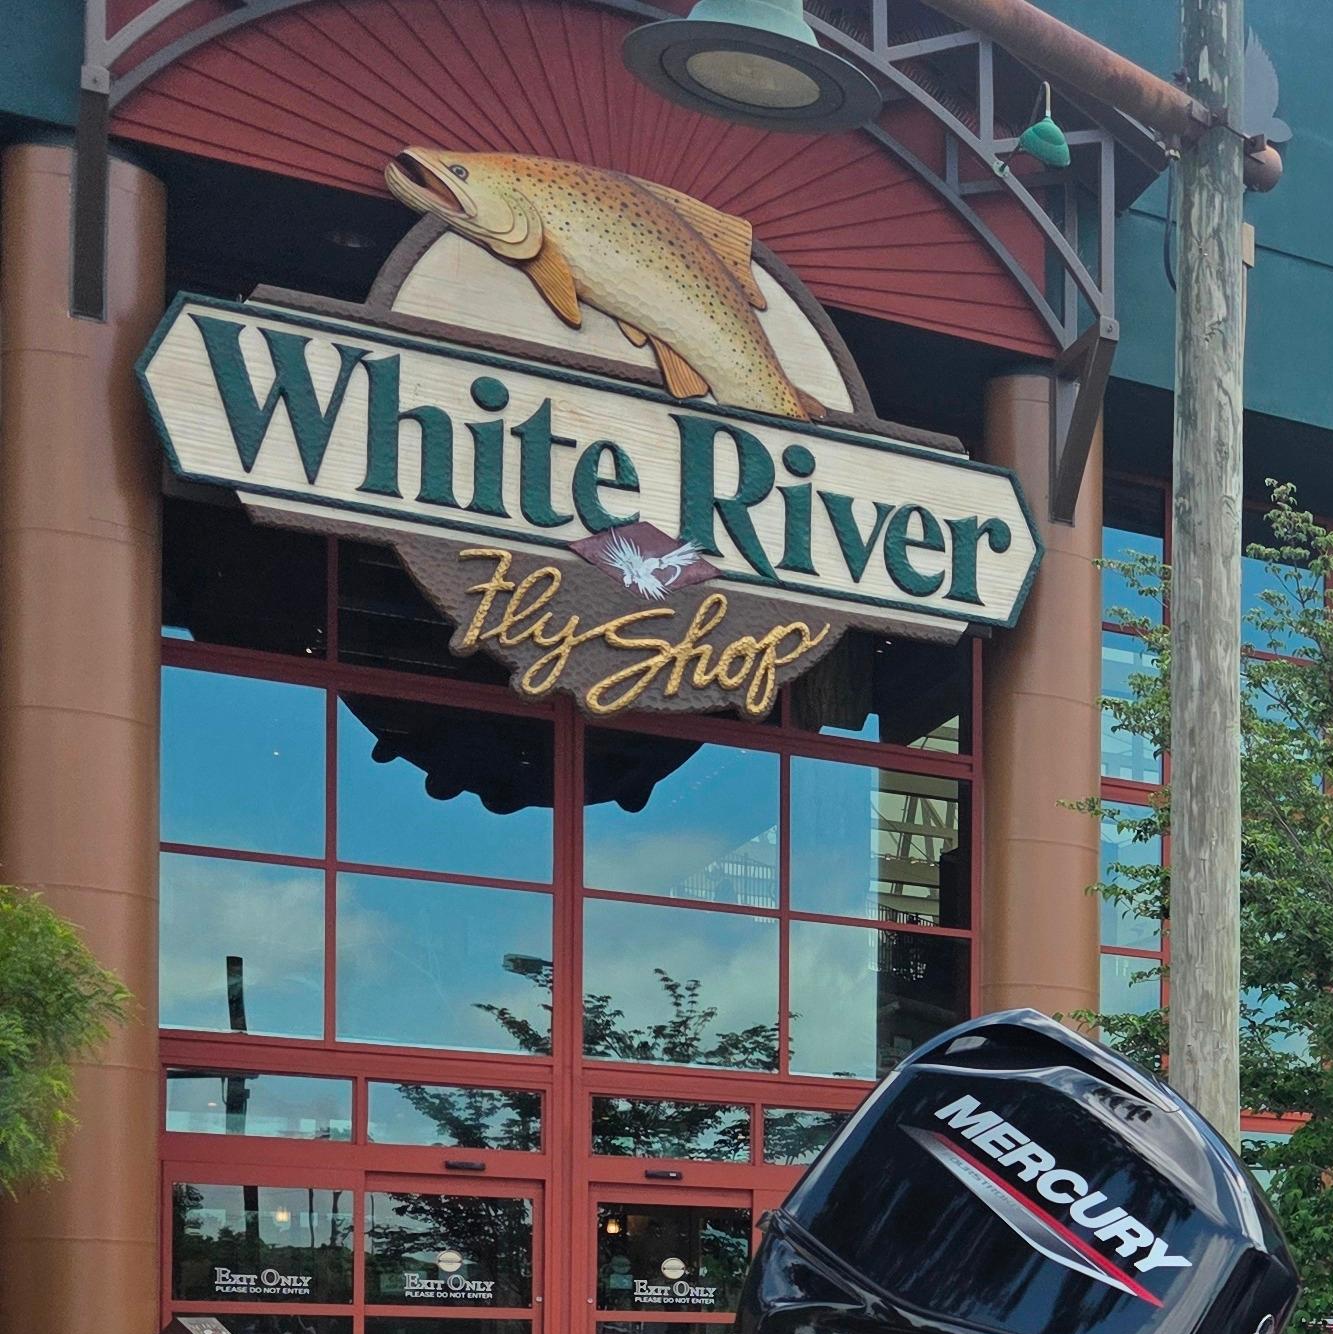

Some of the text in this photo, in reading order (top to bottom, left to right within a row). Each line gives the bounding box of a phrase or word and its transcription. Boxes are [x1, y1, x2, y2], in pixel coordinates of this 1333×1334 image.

[189, 312, 1012, 605] White River
[452, 548, 830, 716] Fly Shop
[934, 1094, 1193, 1273] MERCURY
[215, 1286, 247, 1294] PLEASE
[283, 1287, 310, 1295] ENTER
